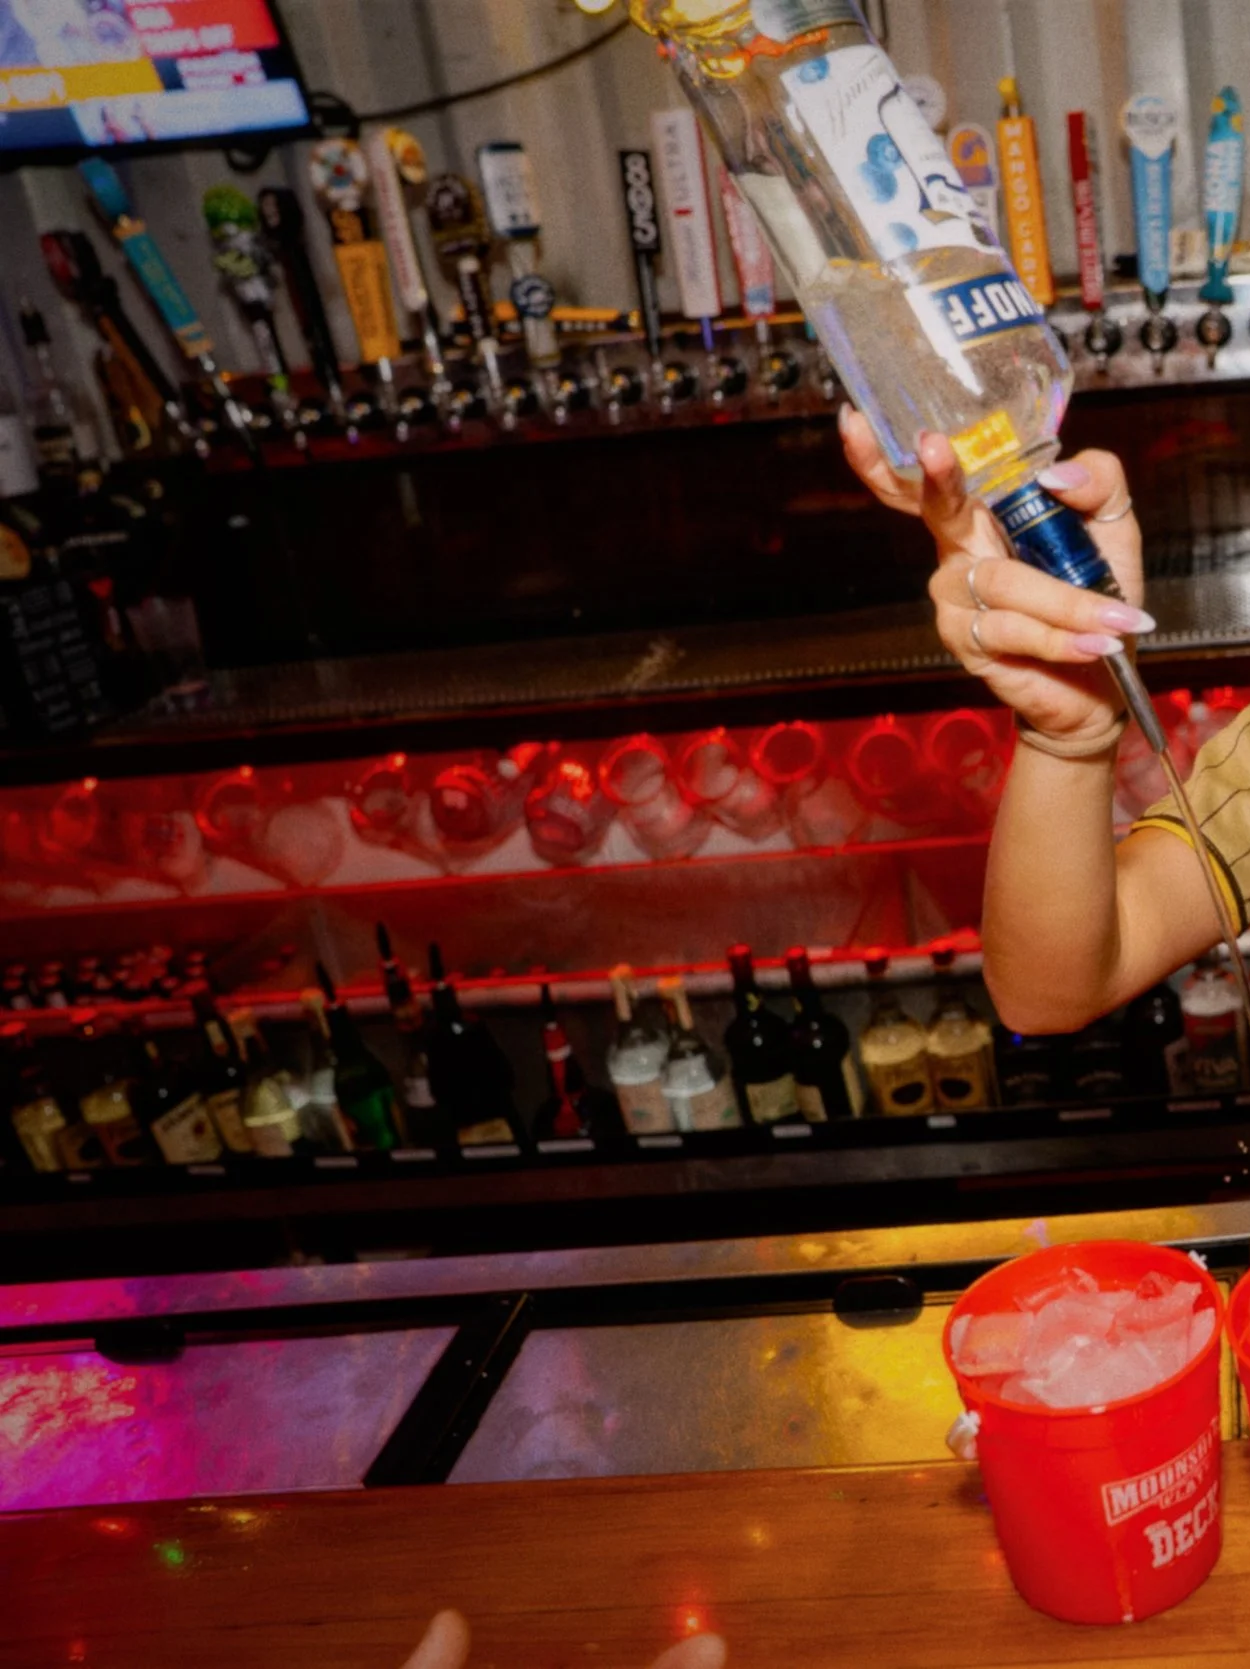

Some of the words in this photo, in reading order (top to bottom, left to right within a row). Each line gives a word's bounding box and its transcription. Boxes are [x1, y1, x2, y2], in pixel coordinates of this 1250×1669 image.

[623, 152, 658, 245] 805
[1003, 122, 1031, 212] MANGO
[1017, 221, 1038, 290] CART
[950, 279, 1045, 336] NOFF
